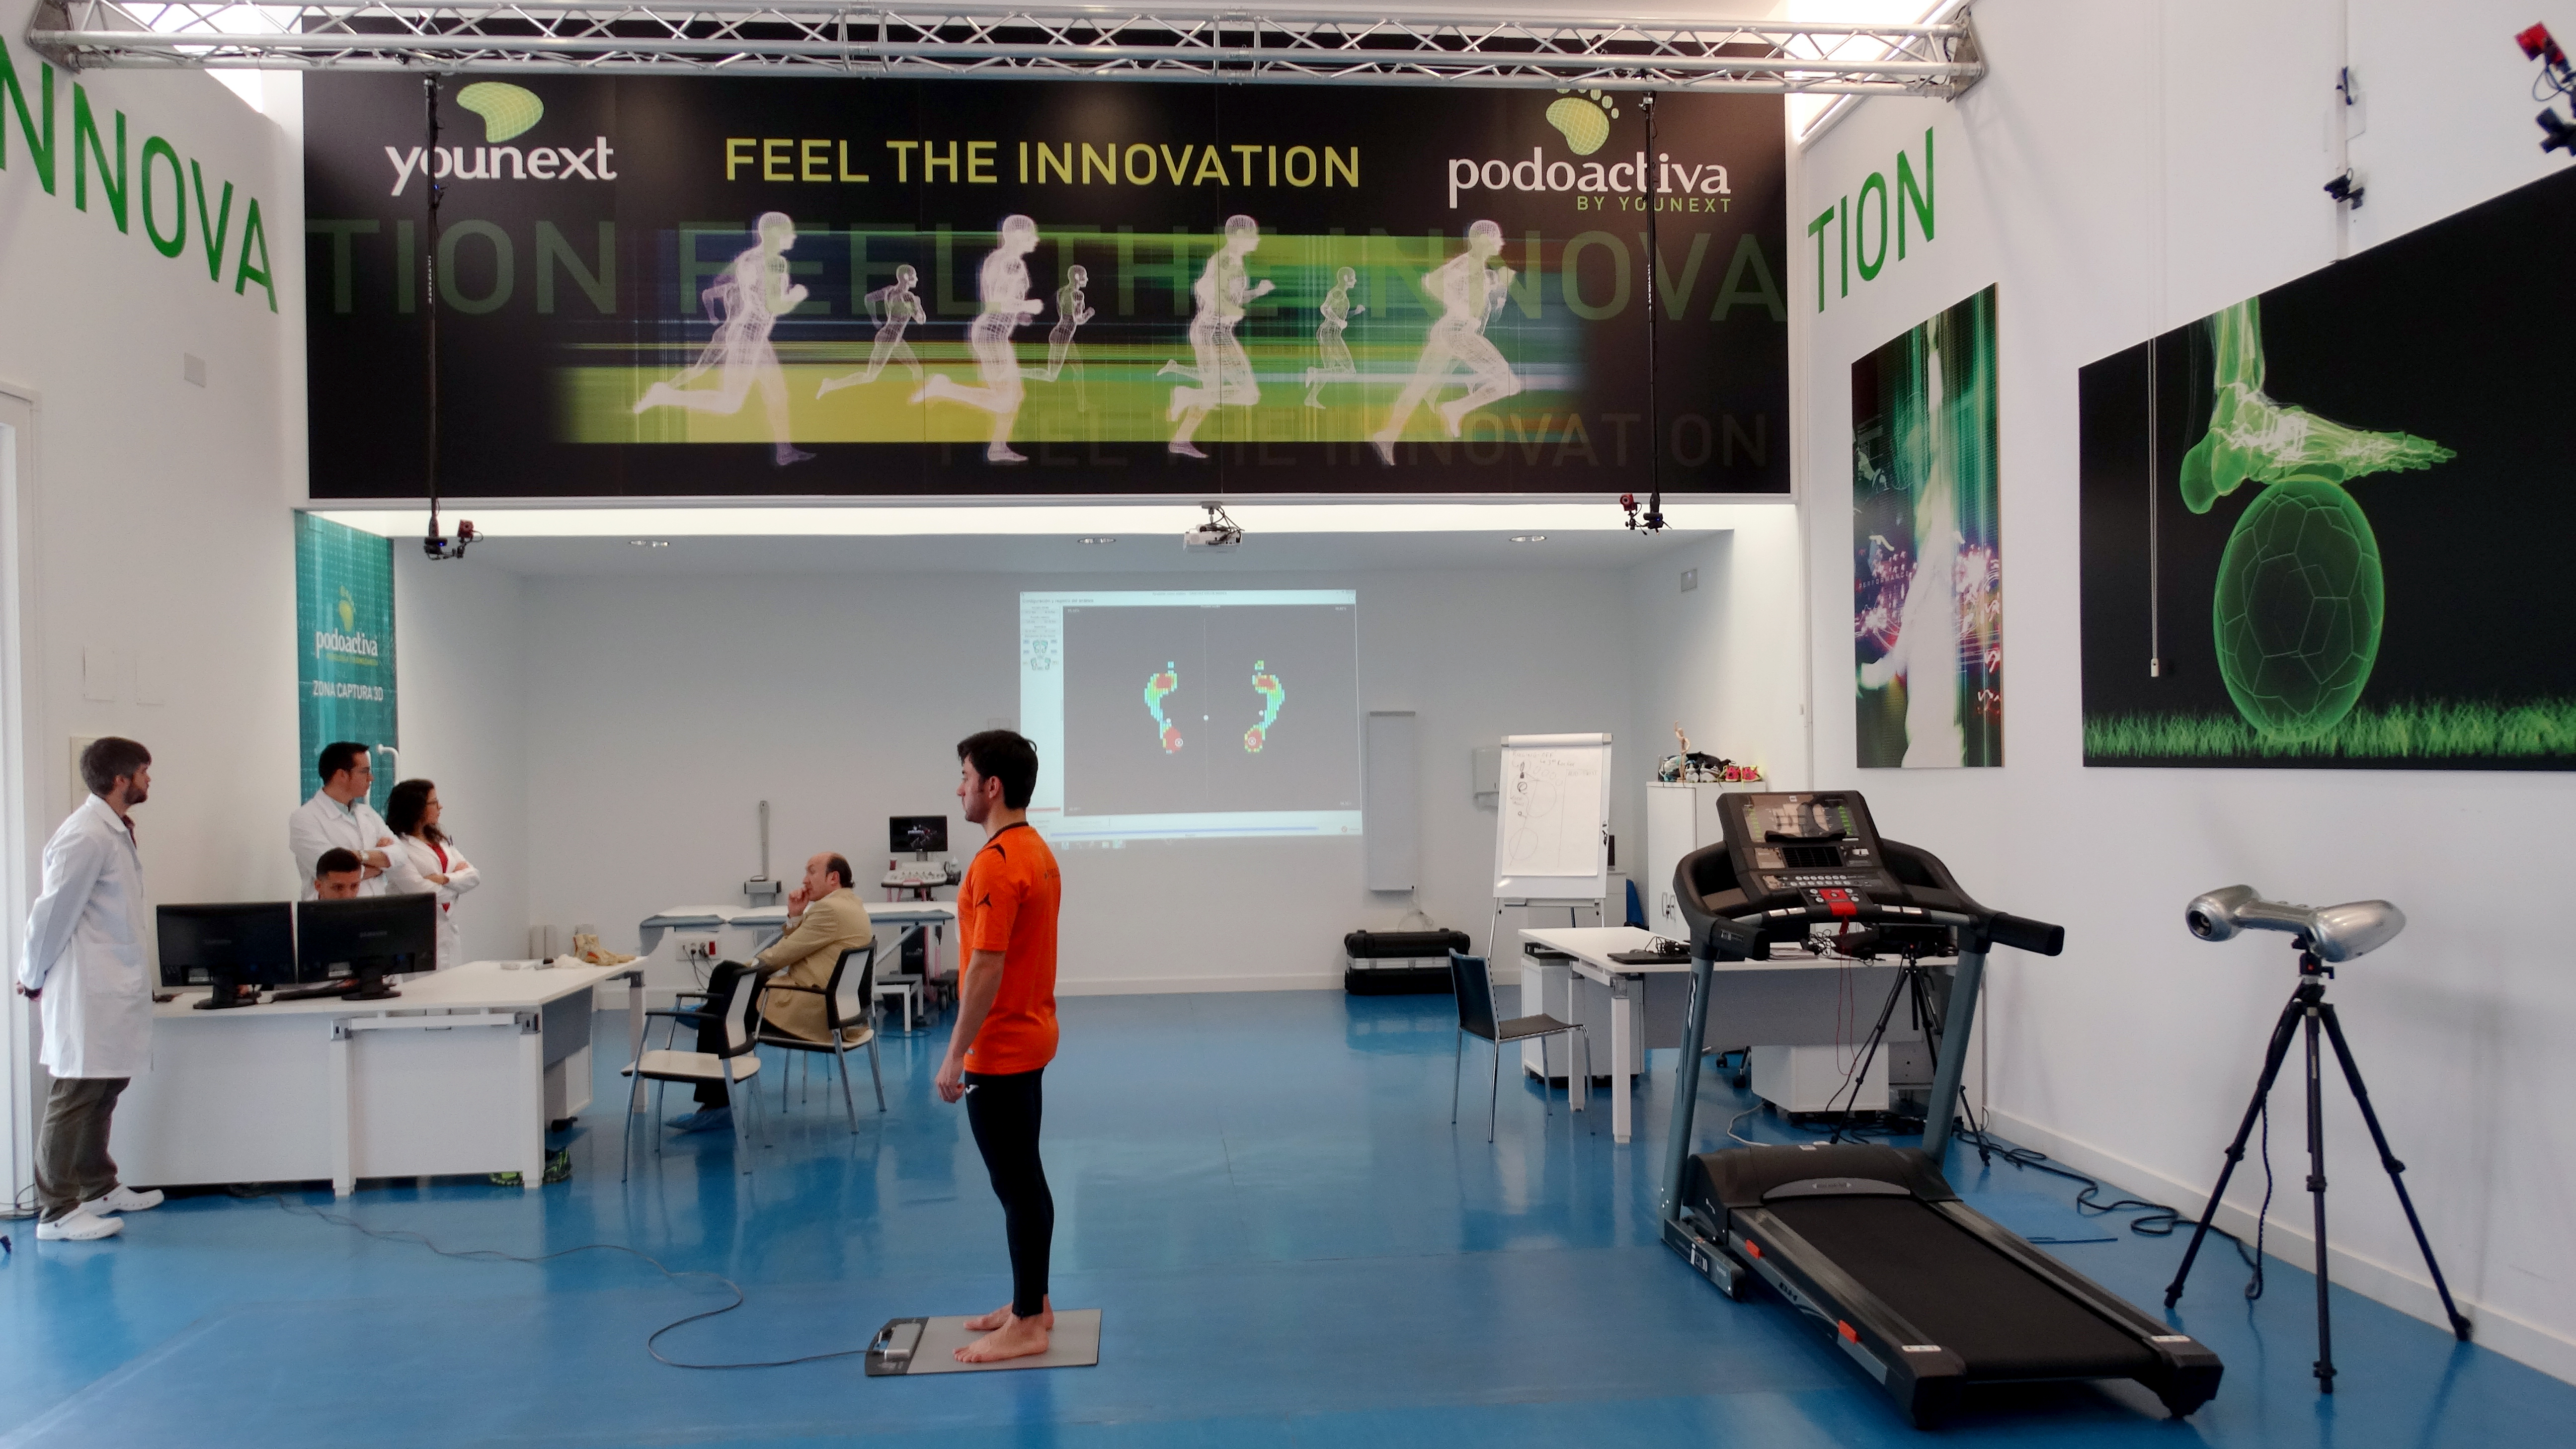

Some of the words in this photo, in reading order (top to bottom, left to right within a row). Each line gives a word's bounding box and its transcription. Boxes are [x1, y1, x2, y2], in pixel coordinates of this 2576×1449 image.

[385, 136, 618, 196] younext
[726, 138, 869, 182] FEEL
[886, 140, 997, 183] THE
[1019, 142, 1359, 187] INNOVATION
[1449, 147, 1731, 209] podoactiva
[1577, 196, 1605, 211] BY
[1619, 196, 1731, 213] YOUNEXT
[1807, 126, 1934, 314] TION
[306, 219, 617, 315] TION
[315, 628, 379, 659] podoactiva
[313, 680, 335, 696] ZONA
[336, 682, 373, 701] CAPTURA
[374, 686, 384, 702] 3D
